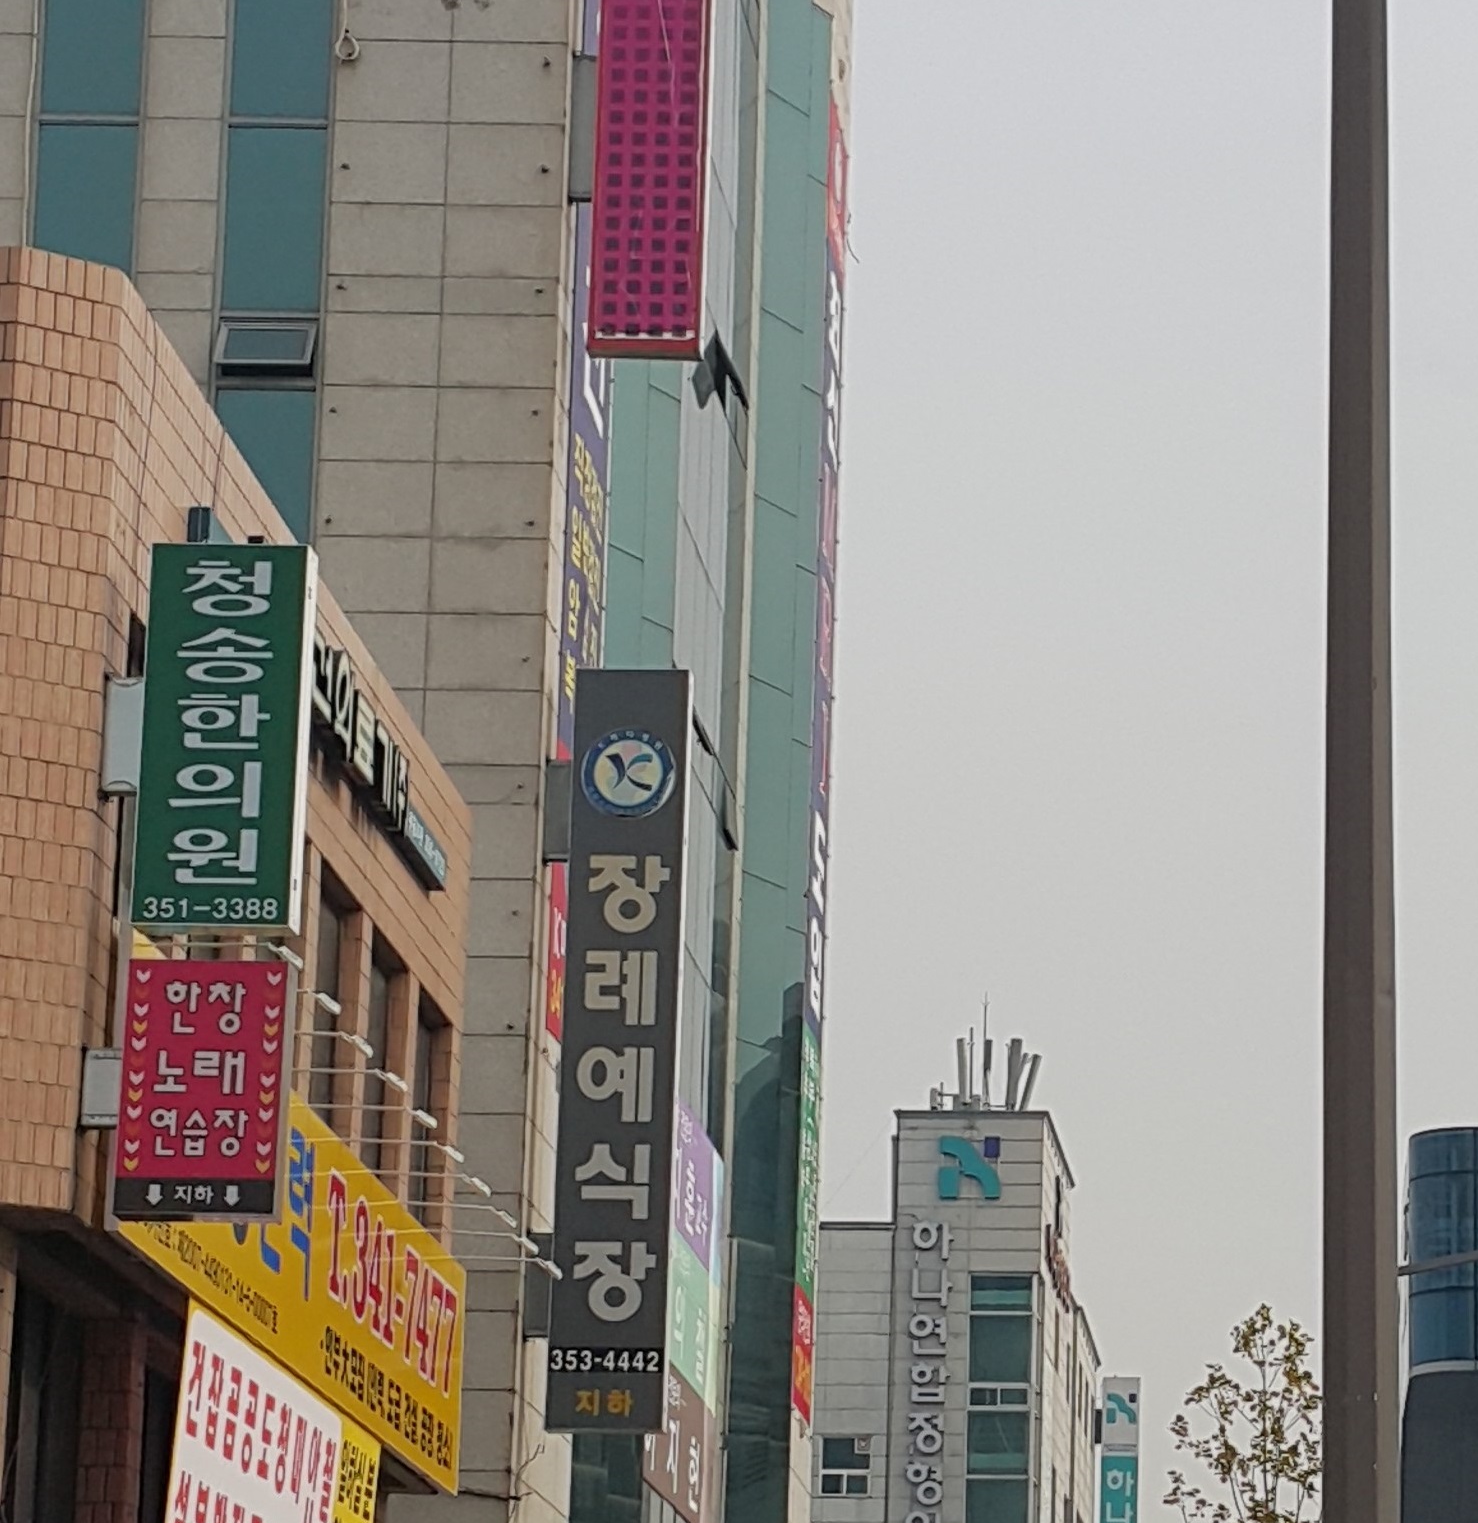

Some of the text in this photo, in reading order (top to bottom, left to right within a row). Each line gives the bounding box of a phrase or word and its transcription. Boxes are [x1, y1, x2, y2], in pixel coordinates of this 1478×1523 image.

[167, 559, 275, 886] 청송한의원
[143, 896, 279, 920] 351-3388
[165, 980, 246, 1035] 한창
[153, 1048, 246, 1096] 노래
[572, 854, 671, 1322] 장례예식장
[149, 1106, 249, 1158] 연습장
[174, 1184, 214, 1204] 지하
[550, 1348, 660, 1373] 353-4442
[575, 1389, 634, 1417] 지하
